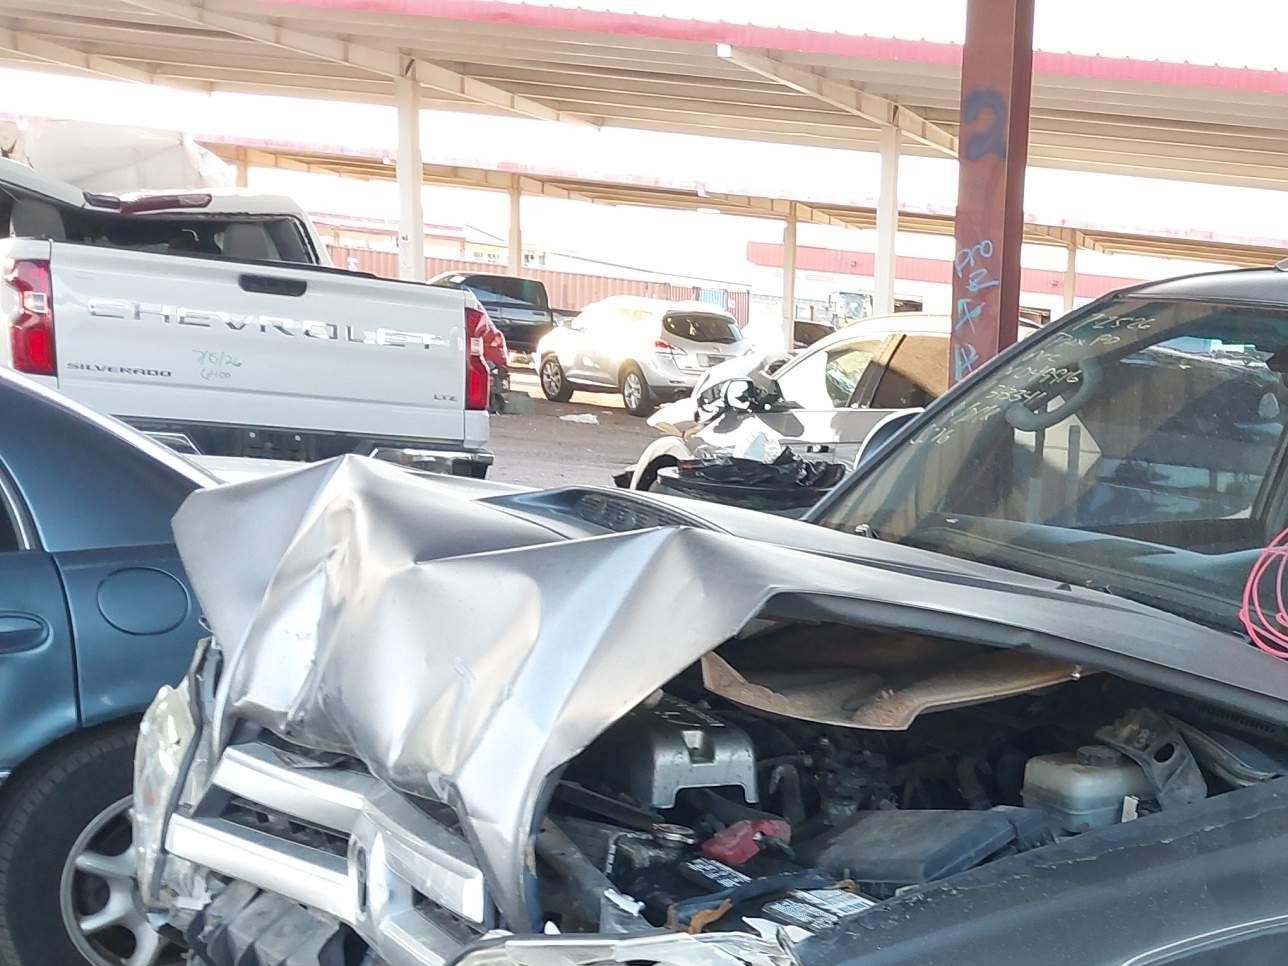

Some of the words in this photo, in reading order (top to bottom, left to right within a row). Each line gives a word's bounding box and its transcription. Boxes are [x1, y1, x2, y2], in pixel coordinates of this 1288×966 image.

[86, 298, 451, 350] CHEVROLET
[66, 362, 173, 378] SILVERADO
[433, 393, 457, 402] LTZ
